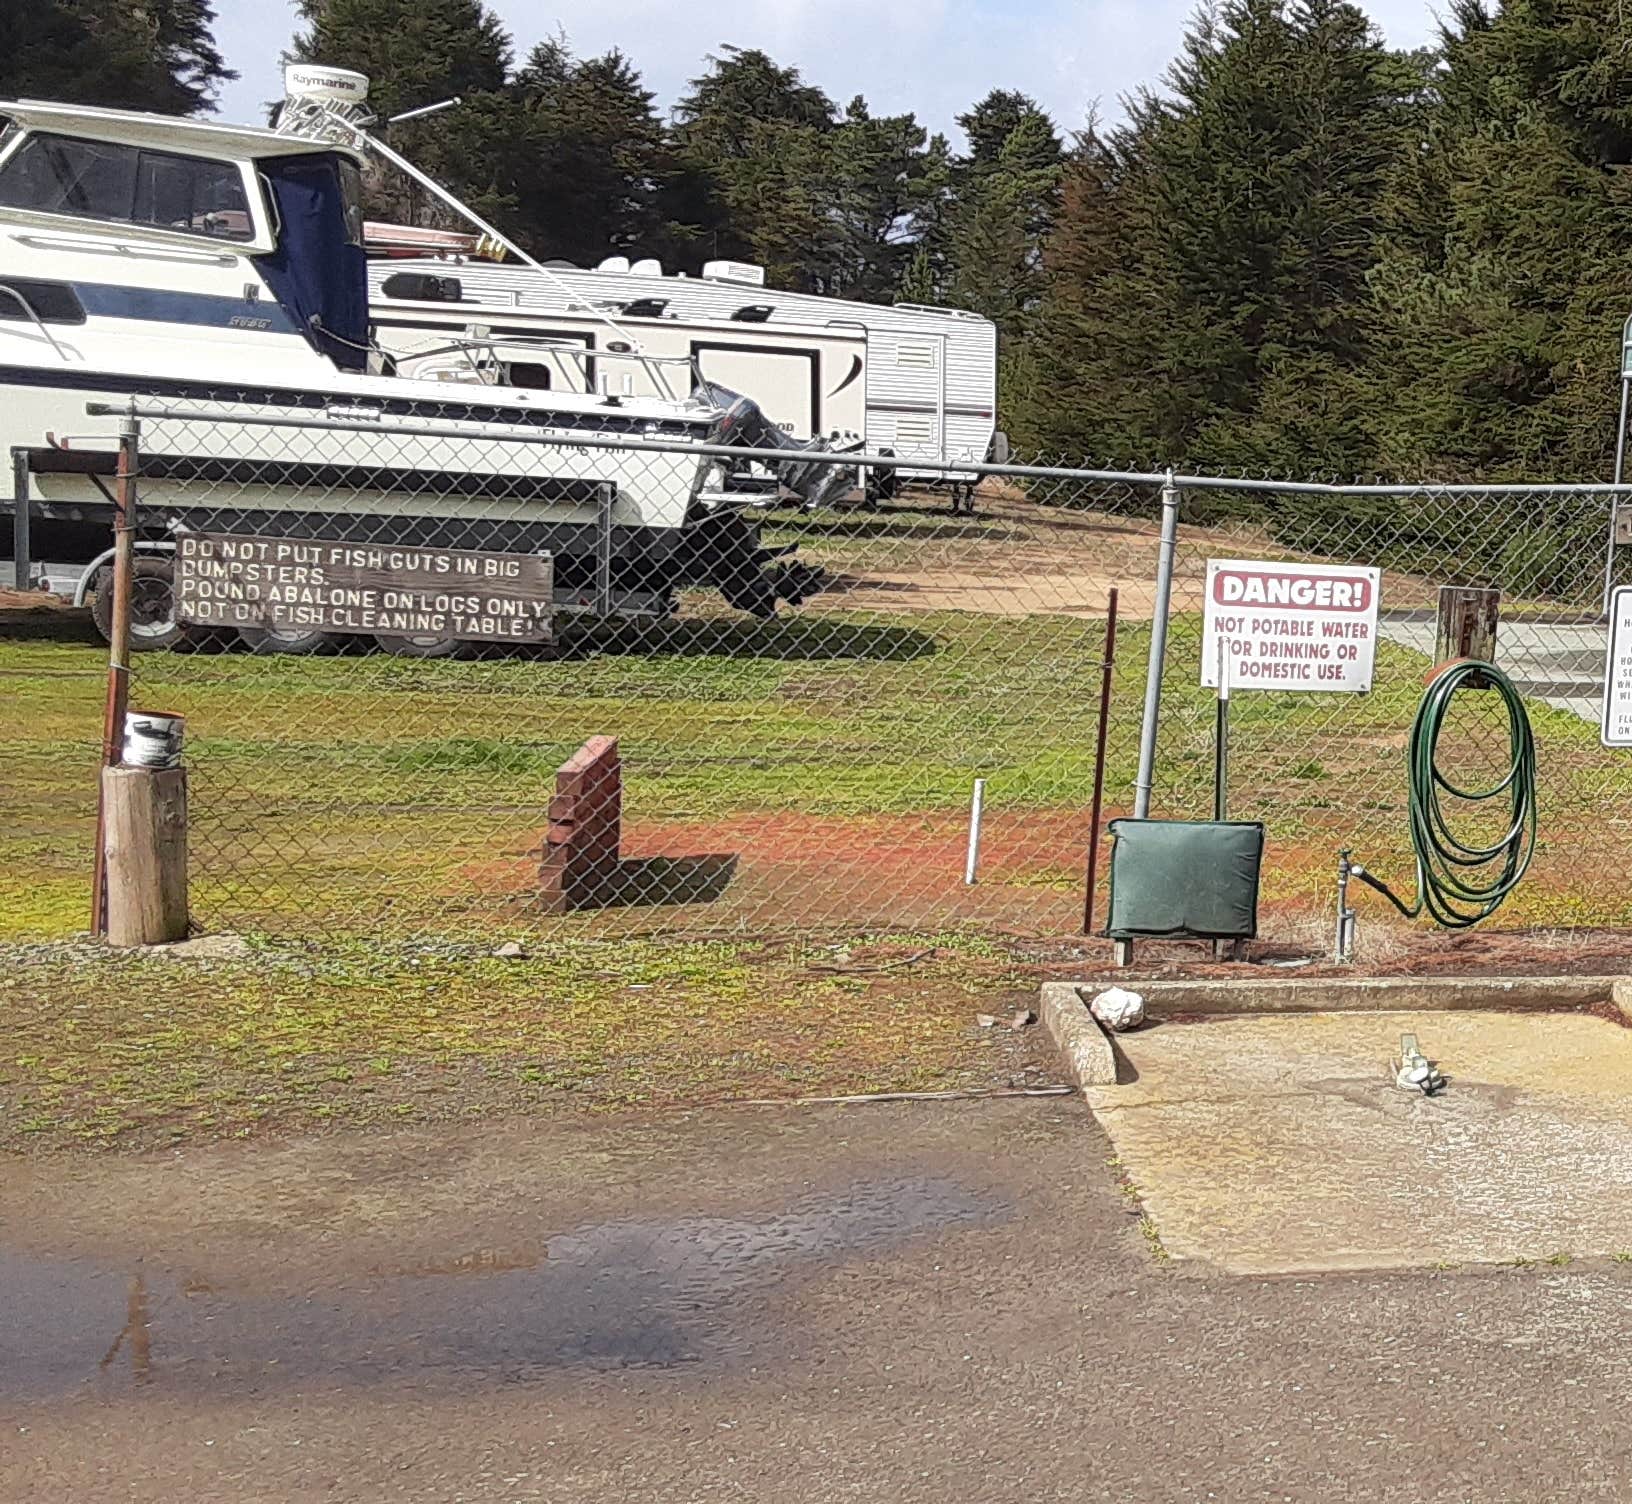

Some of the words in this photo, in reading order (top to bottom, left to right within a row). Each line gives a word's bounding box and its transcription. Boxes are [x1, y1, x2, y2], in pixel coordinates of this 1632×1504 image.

[293, 74, 356, 90] Raymarine
[182, 538, 214, 557] DO
[222, 541, 269, 560] NOT
[277, 544, 322, 564] PUT
[330, 548, 382, 569] FISH
[389, 552, 450, 573] GUTS
[456, 557, 477, 575] IN
[484, 558, 520, 577] BIG
[182, 559, 331, 586] DUMPSTERS.
[180, 579, 260, 600] POUND
[268, 585, 377, 609] ABALONE
[383, 592, 413, 609] ON
[420, 594, 481, 614] LOGS
[486, 598, 546, 618] ONLY
[1223, 575, 1364, 607] DANGER!
[180, 600, 228, 618] NOT
[235, 603, 266, 621] ON
[273, 605, 324, 625] FISH
[331, 608, 446, 631] CLEANING
[451, 614, 534, 636] TABLE!
[1214, 616, 1246, 633] NOT
[1251, 618, 1315, 637] POTABLE
[1322, 621, 1369, 639] WATER
[1259, 641, 1330, 660] DRINKING
[1337, 644, 1358, 661] OR
[1239, 661, 1311, 680] DOMESTIC
[1317, 664, 1346, 681] USE.
[1618, 726, 1630, 735] ON
